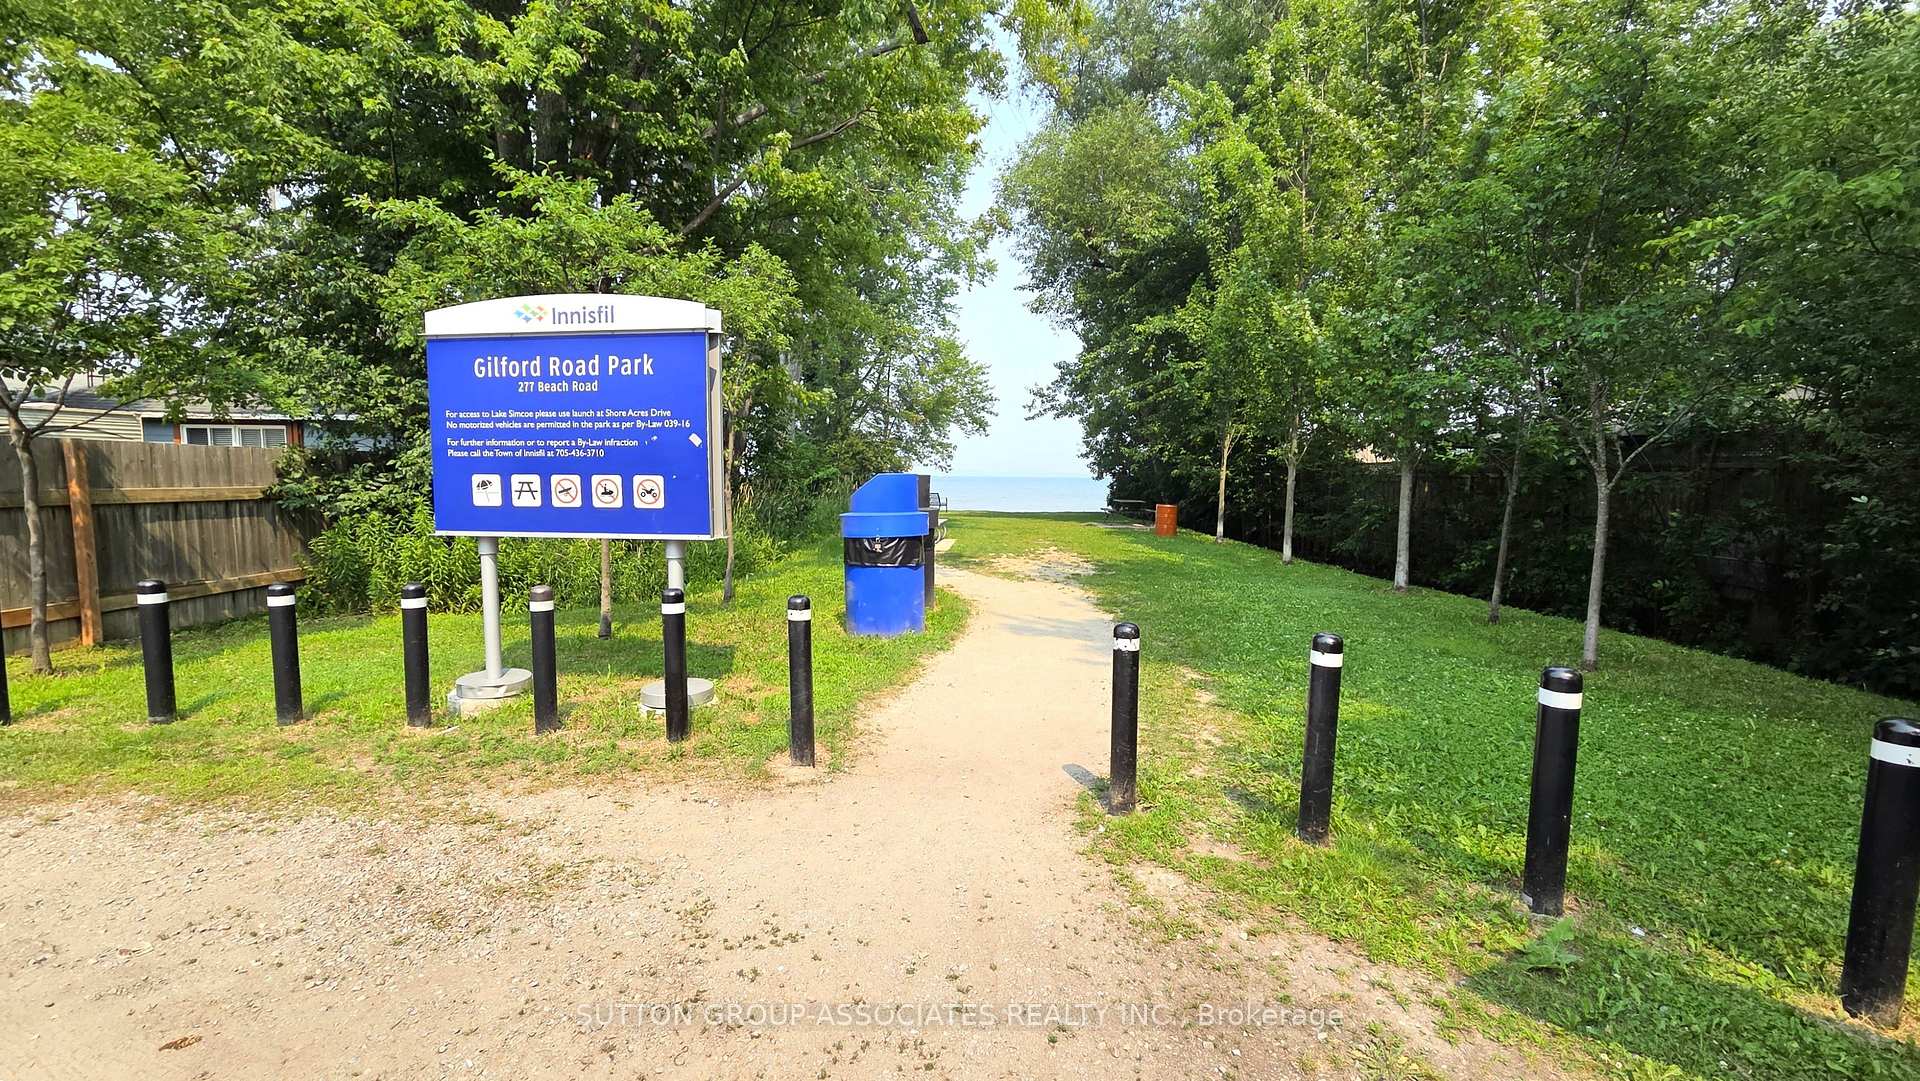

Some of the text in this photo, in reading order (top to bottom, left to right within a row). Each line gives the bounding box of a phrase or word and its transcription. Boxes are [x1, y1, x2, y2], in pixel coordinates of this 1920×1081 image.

[552, 305, 615, 325] Innisfil
[473, 353, 655, 378] Gilford Road Park
[518, 380, 598, 393] 277 Beach Road
[445, 410, 458, 418] For
[482, 410, 490, 418] to
[491, 410, 507, 418] Lake
[508, 409, 534, 418] Simcoe
[535, 409, 557, 419] please
[572, 409, 595, 417] launch
[596, 409, 604, 417] at
[605, 408, 627, 417] Shore
[627, 408, 649, 417] Acres
[650, 408, 672, 417] Drive
[446, 421, 458, 429] No
[459, 420, 494, 429] motorized
[494, 420, 522, 428] vehicles
[536, 420, 571, 430] permitted
[572, 420, 580, 428] in
[581, 420, 593, 428] the
[594, 419, 611, 430] park
[612, 420, 621, 428] as
[621, 420, 634, 430] per
[636, 419, 662, 430] By-Law
[664, 419, 691, 428] 039-16
[447, 438, 459, 446] For
[460, 438, 485, 446] further
[486, 438, 525, 446] information
[537, 438, 545, 446] to
[546, 439, 570, 447] report
[577, 438, 603, 448] By-Law
[604, 438, 639, 446] infraction
[447, 449, 469, 457] Please
[469, 449, 481, 457] call
[482, 449, 494, 457] the
[494, 449, 514, 457] Town
[514, 449, 523, 457] of
[523, 449, 546, 457] Innisfil
[555, 449, 605, 457] 705-436-3710
